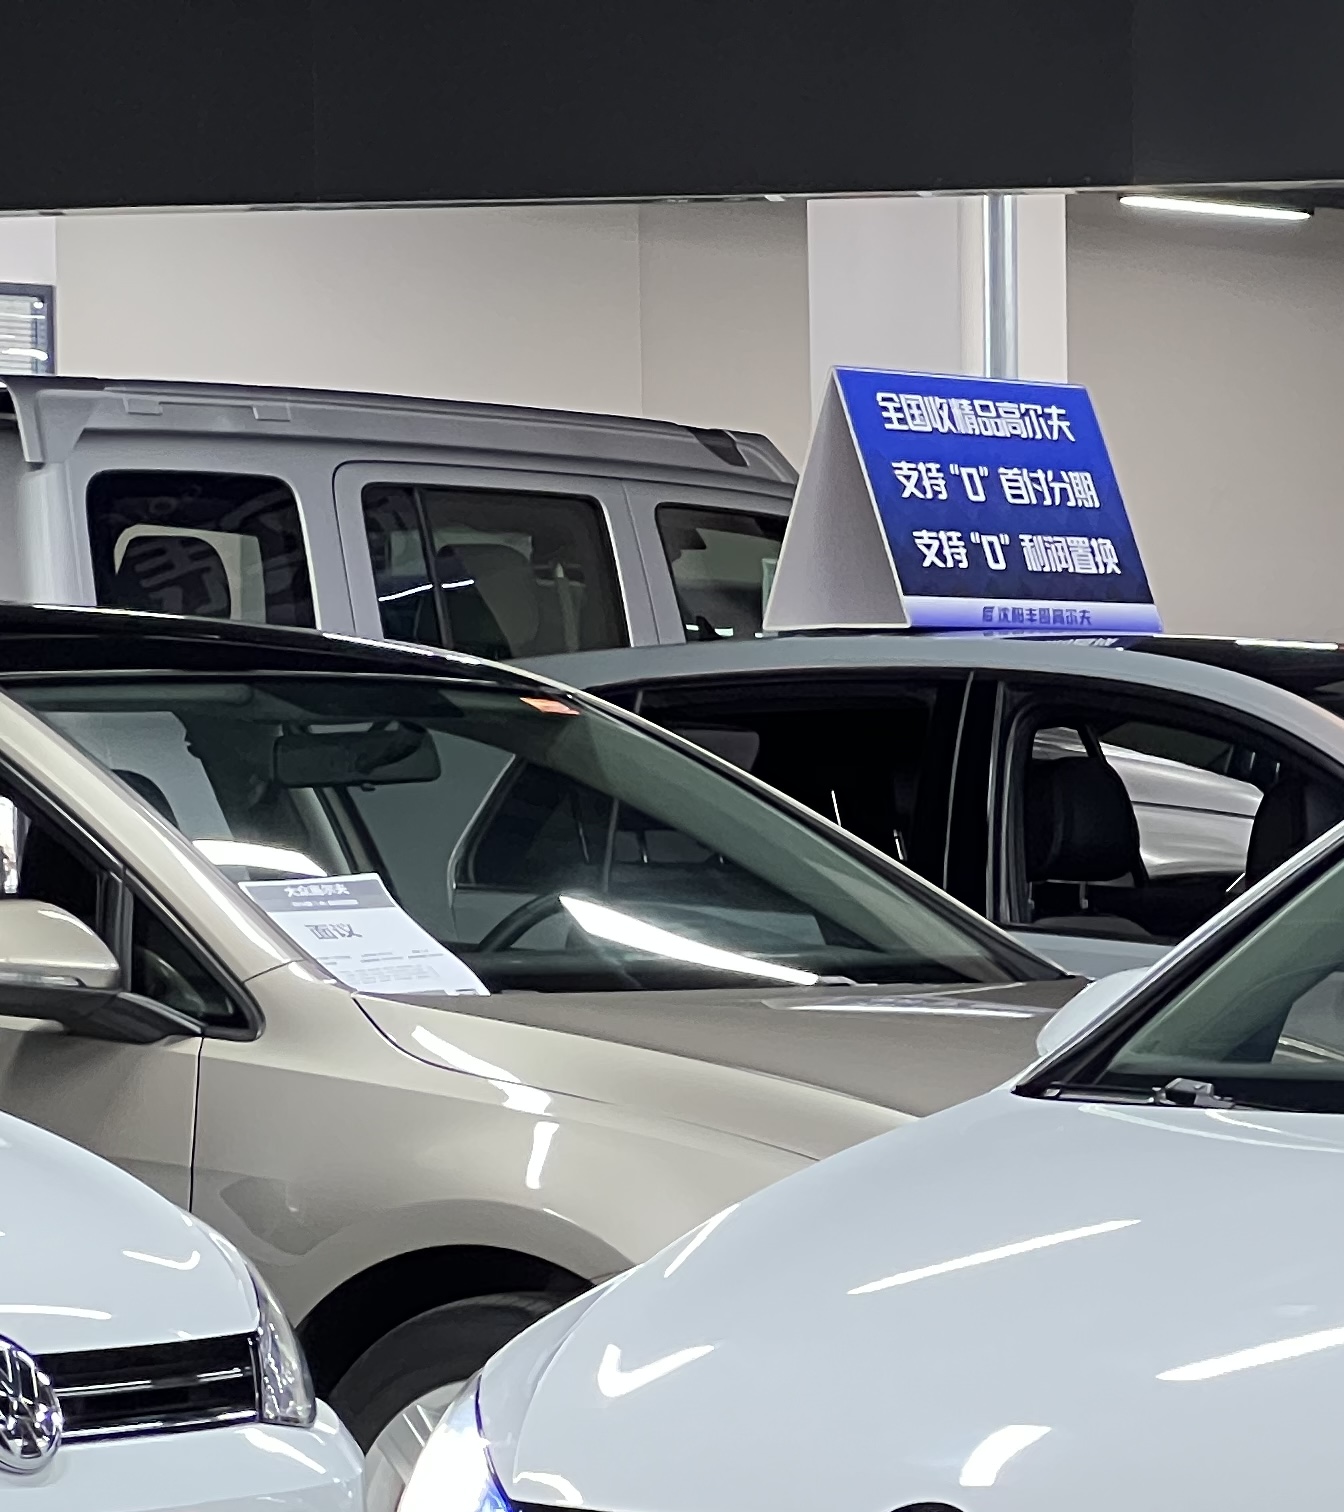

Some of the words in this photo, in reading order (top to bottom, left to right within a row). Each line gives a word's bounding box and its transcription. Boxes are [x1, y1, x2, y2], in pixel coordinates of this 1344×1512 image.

[876, 392, 1076, 442] 全国收精品高尔夫
